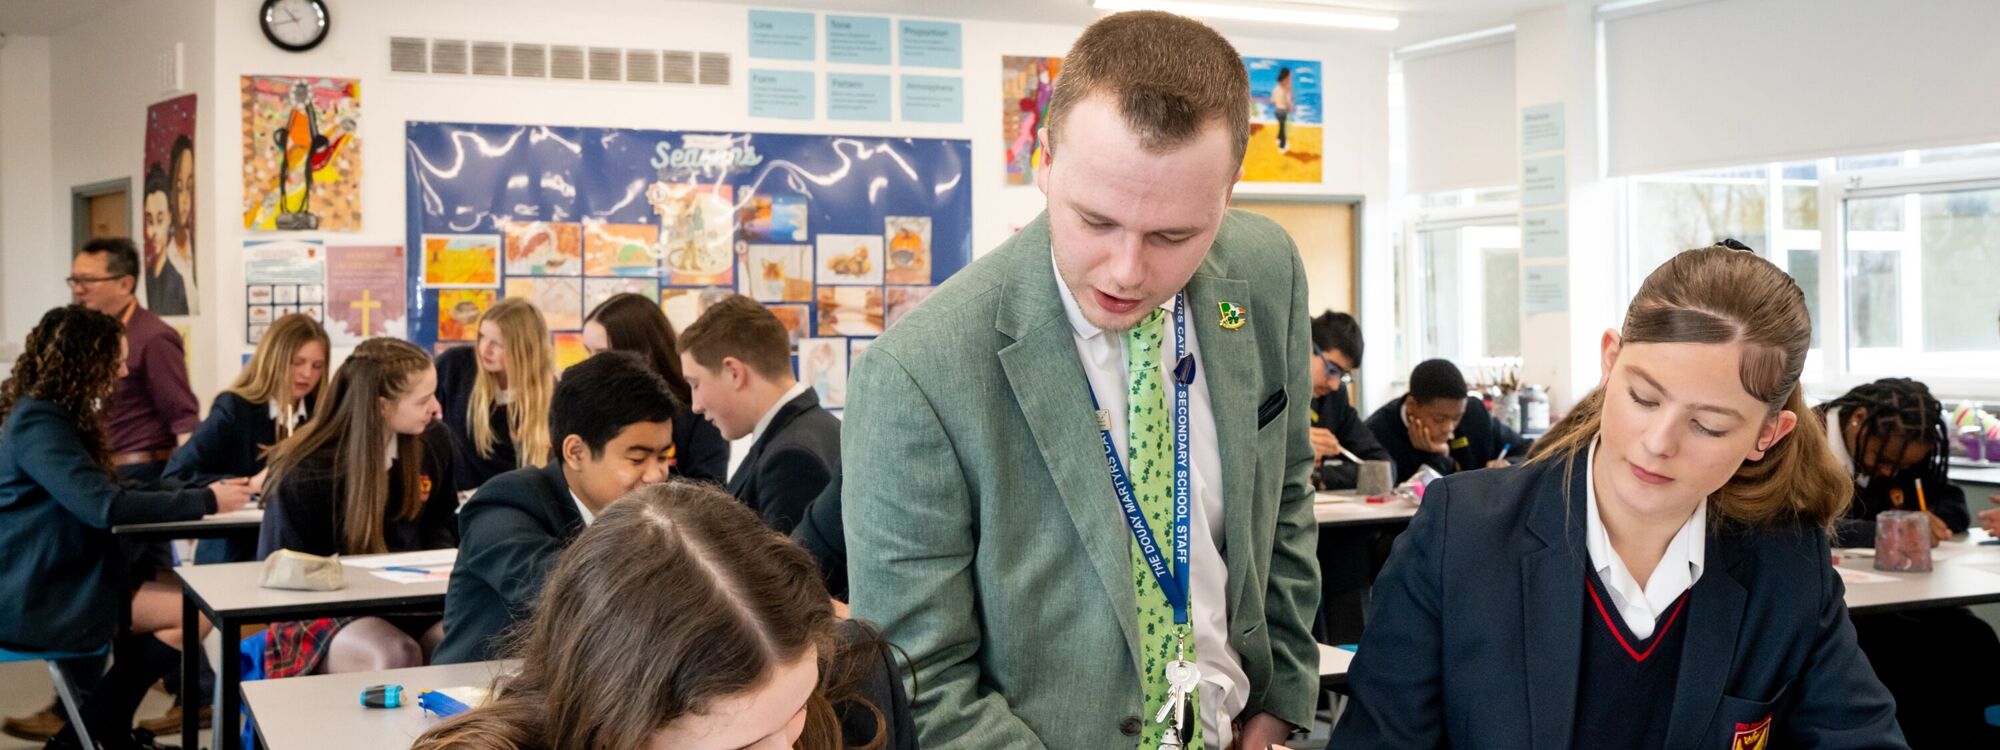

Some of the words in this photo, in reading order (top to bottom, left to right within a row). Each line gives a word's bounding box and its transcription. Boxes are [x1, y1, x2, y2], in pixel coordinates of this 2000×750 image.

[650, 141, 764, 169] Seans
[1177, 390, 1188, 467] SECONDARY
[1108, 456, 1137, 513] MARTYRS
[1177, 471, 1188, 522] SCHOOL
[1129, 515, 1156, 554] DOUAY
[1177, 527, 1188, 564] STAFF
[1149, 554, 1167, 578] THE
